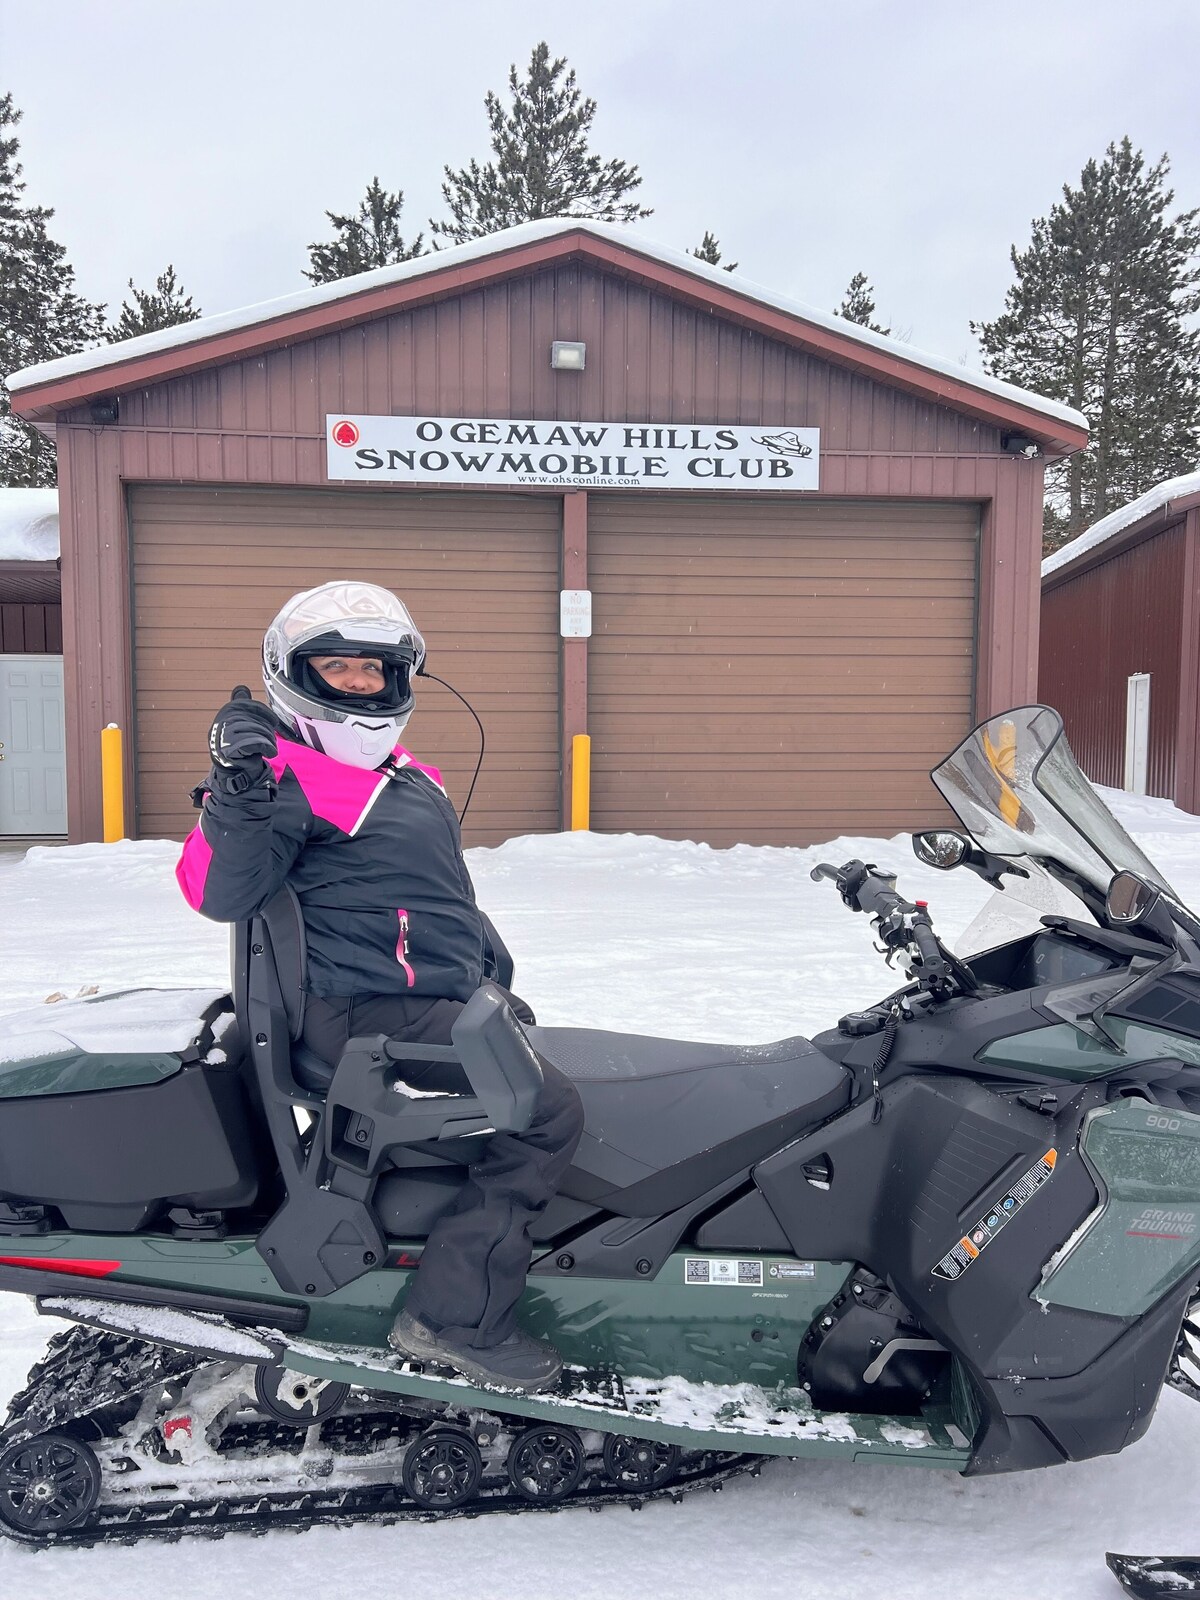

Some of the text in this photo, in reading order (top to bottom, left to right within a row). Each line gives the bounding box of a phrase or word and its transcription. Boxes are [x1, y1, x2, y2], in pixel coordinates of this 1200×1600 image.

[416, 421, 739, 450] OGEMAW HILLS
[354, 448, 794, 479] SNOWMOBILE CLUB
[517, 474, 640, 486] www.ohsconline.com
[1145, 1115, 1181, 1131] 900
[1140, 1208, 1196, 1223] GRAND
[1130, 1218, 1197, 1234] TOURING
